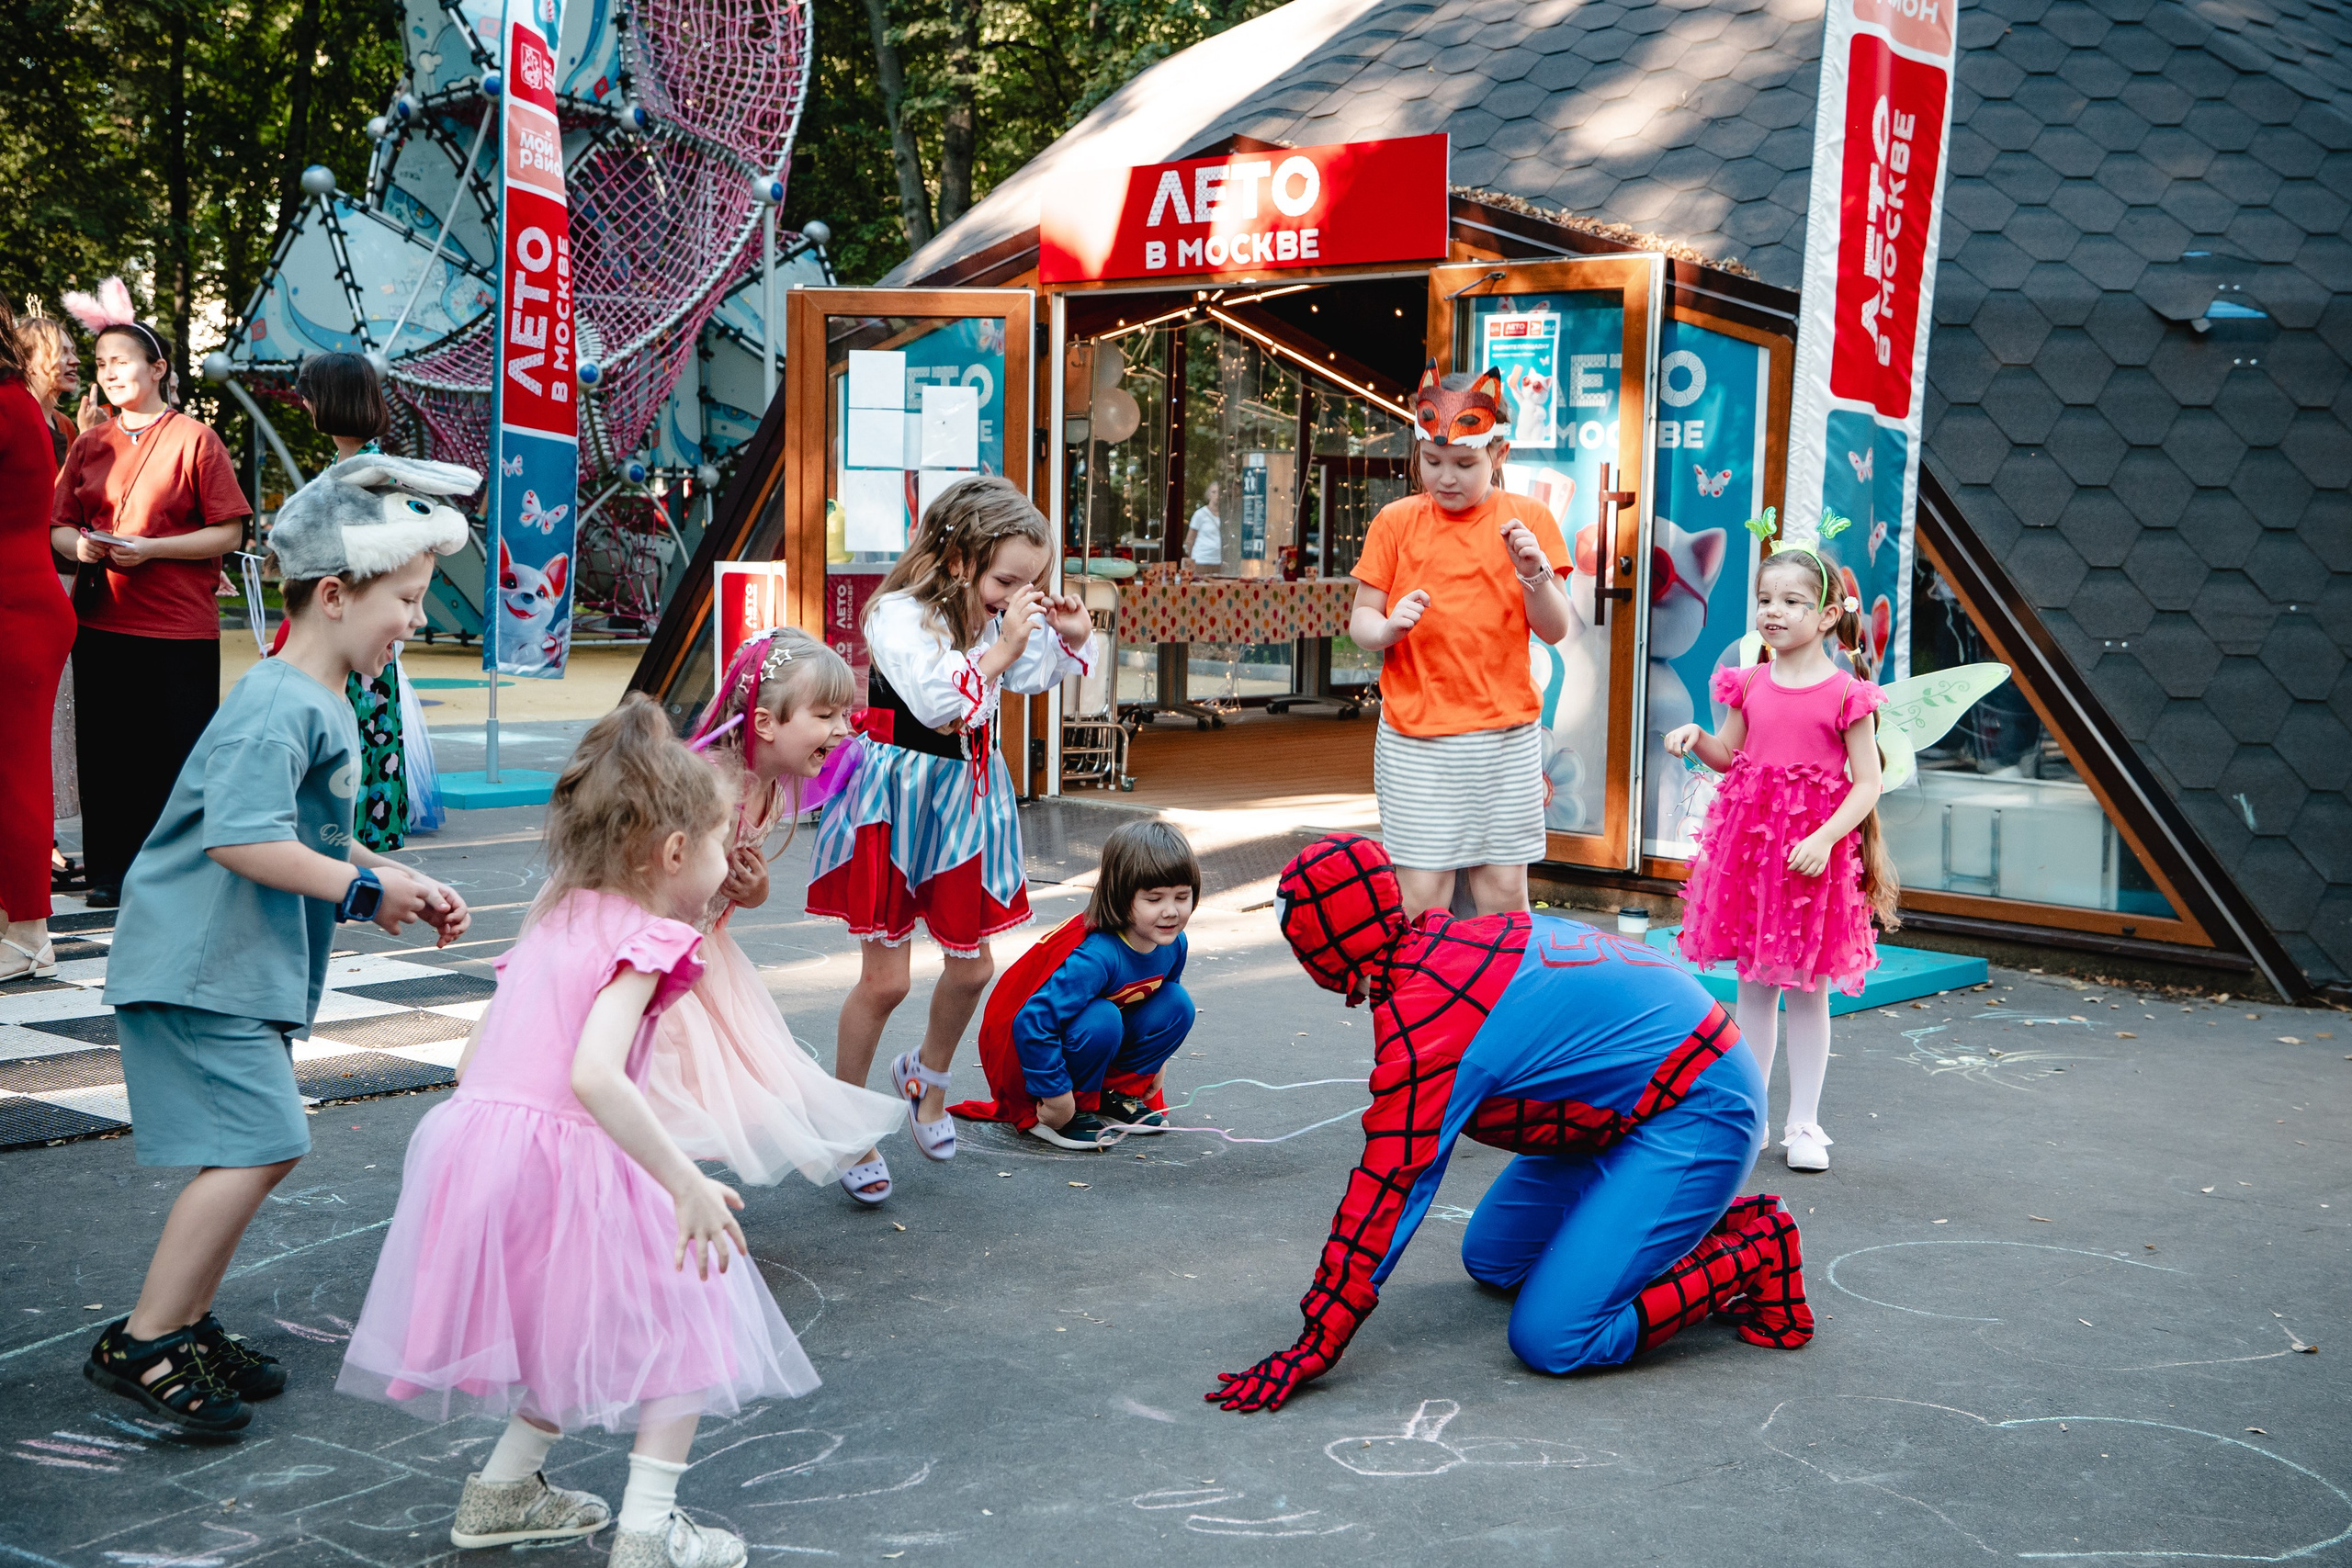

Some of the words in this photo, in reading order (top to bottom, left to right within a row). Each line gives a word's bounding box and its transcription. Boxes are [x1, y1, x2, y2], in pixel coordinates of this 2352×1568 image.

[1147, 155, 1320, 227] ЛЕТО
[1860, 94, 1889, 356] ЛЕТО
[1880, 108, 1916, 320] МОСКВЕ
[1145, 240, 1167, 270] В
[1177, 228, 1320, 267] МОСКВЕ
[507, 226, 553, 397] ЛЕТО
[553, 234, 571, 372] МОСКВЕ
[1877, 333, 1892, 367] В
[551, 380, 569, 403] В
[836, 584, 847, 629] ЛЕТО
